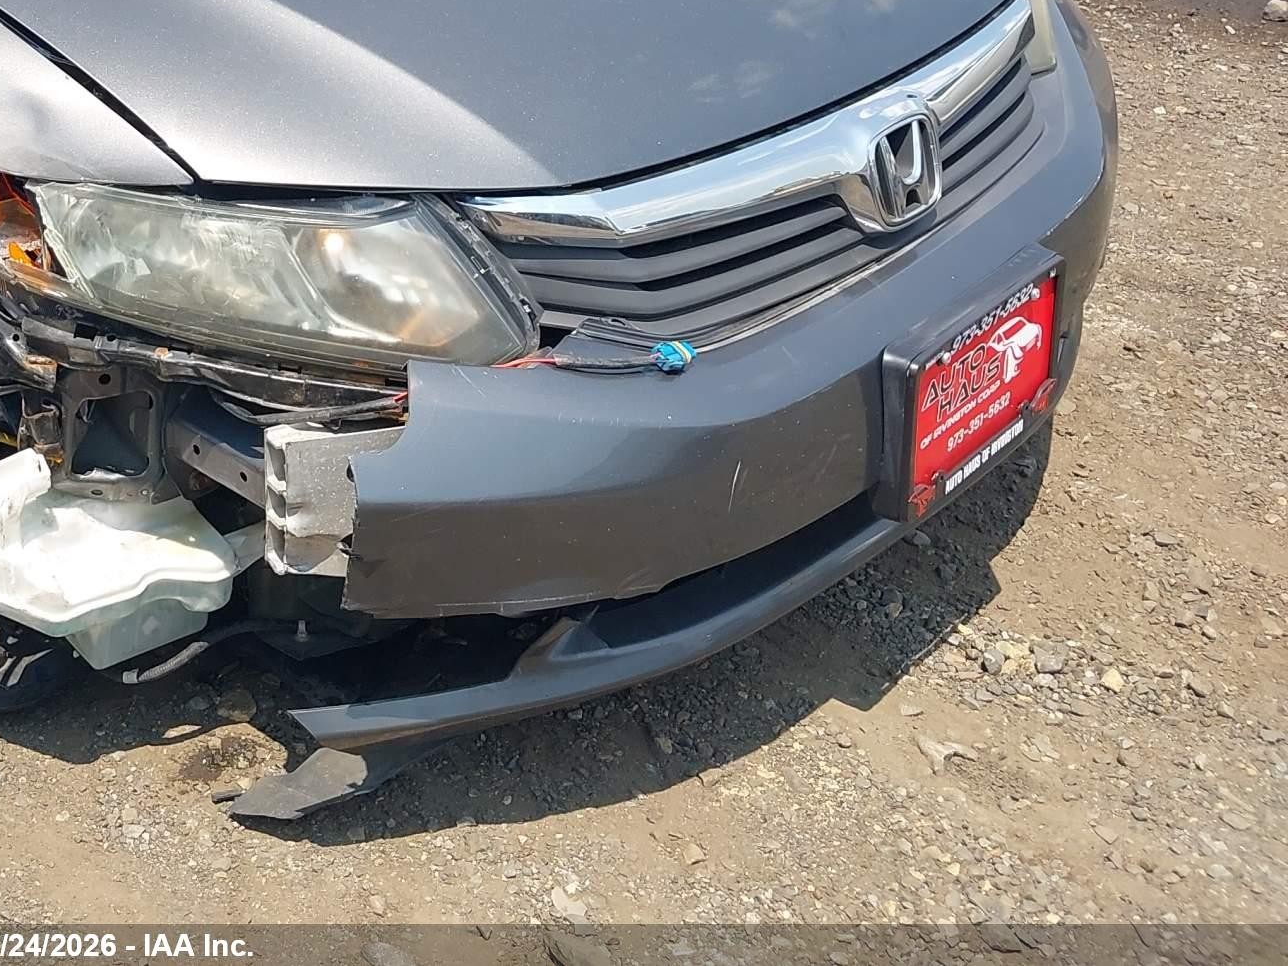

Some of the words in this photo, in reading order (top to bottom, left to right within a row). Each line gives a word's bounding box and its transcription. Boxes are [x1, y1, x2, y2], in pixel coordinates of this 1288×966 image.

[921, 343, 987, 412] AUTO
[936, 352, 1003, 422] HAUS
[920, 432, 934, 450] OF
[947, 391, 1011, 452] 973-351-5632
[945, 468, 963, 495] AUTO
[963, 452, 981, 480] HAUS
[981, 445, 992, 464] OF
